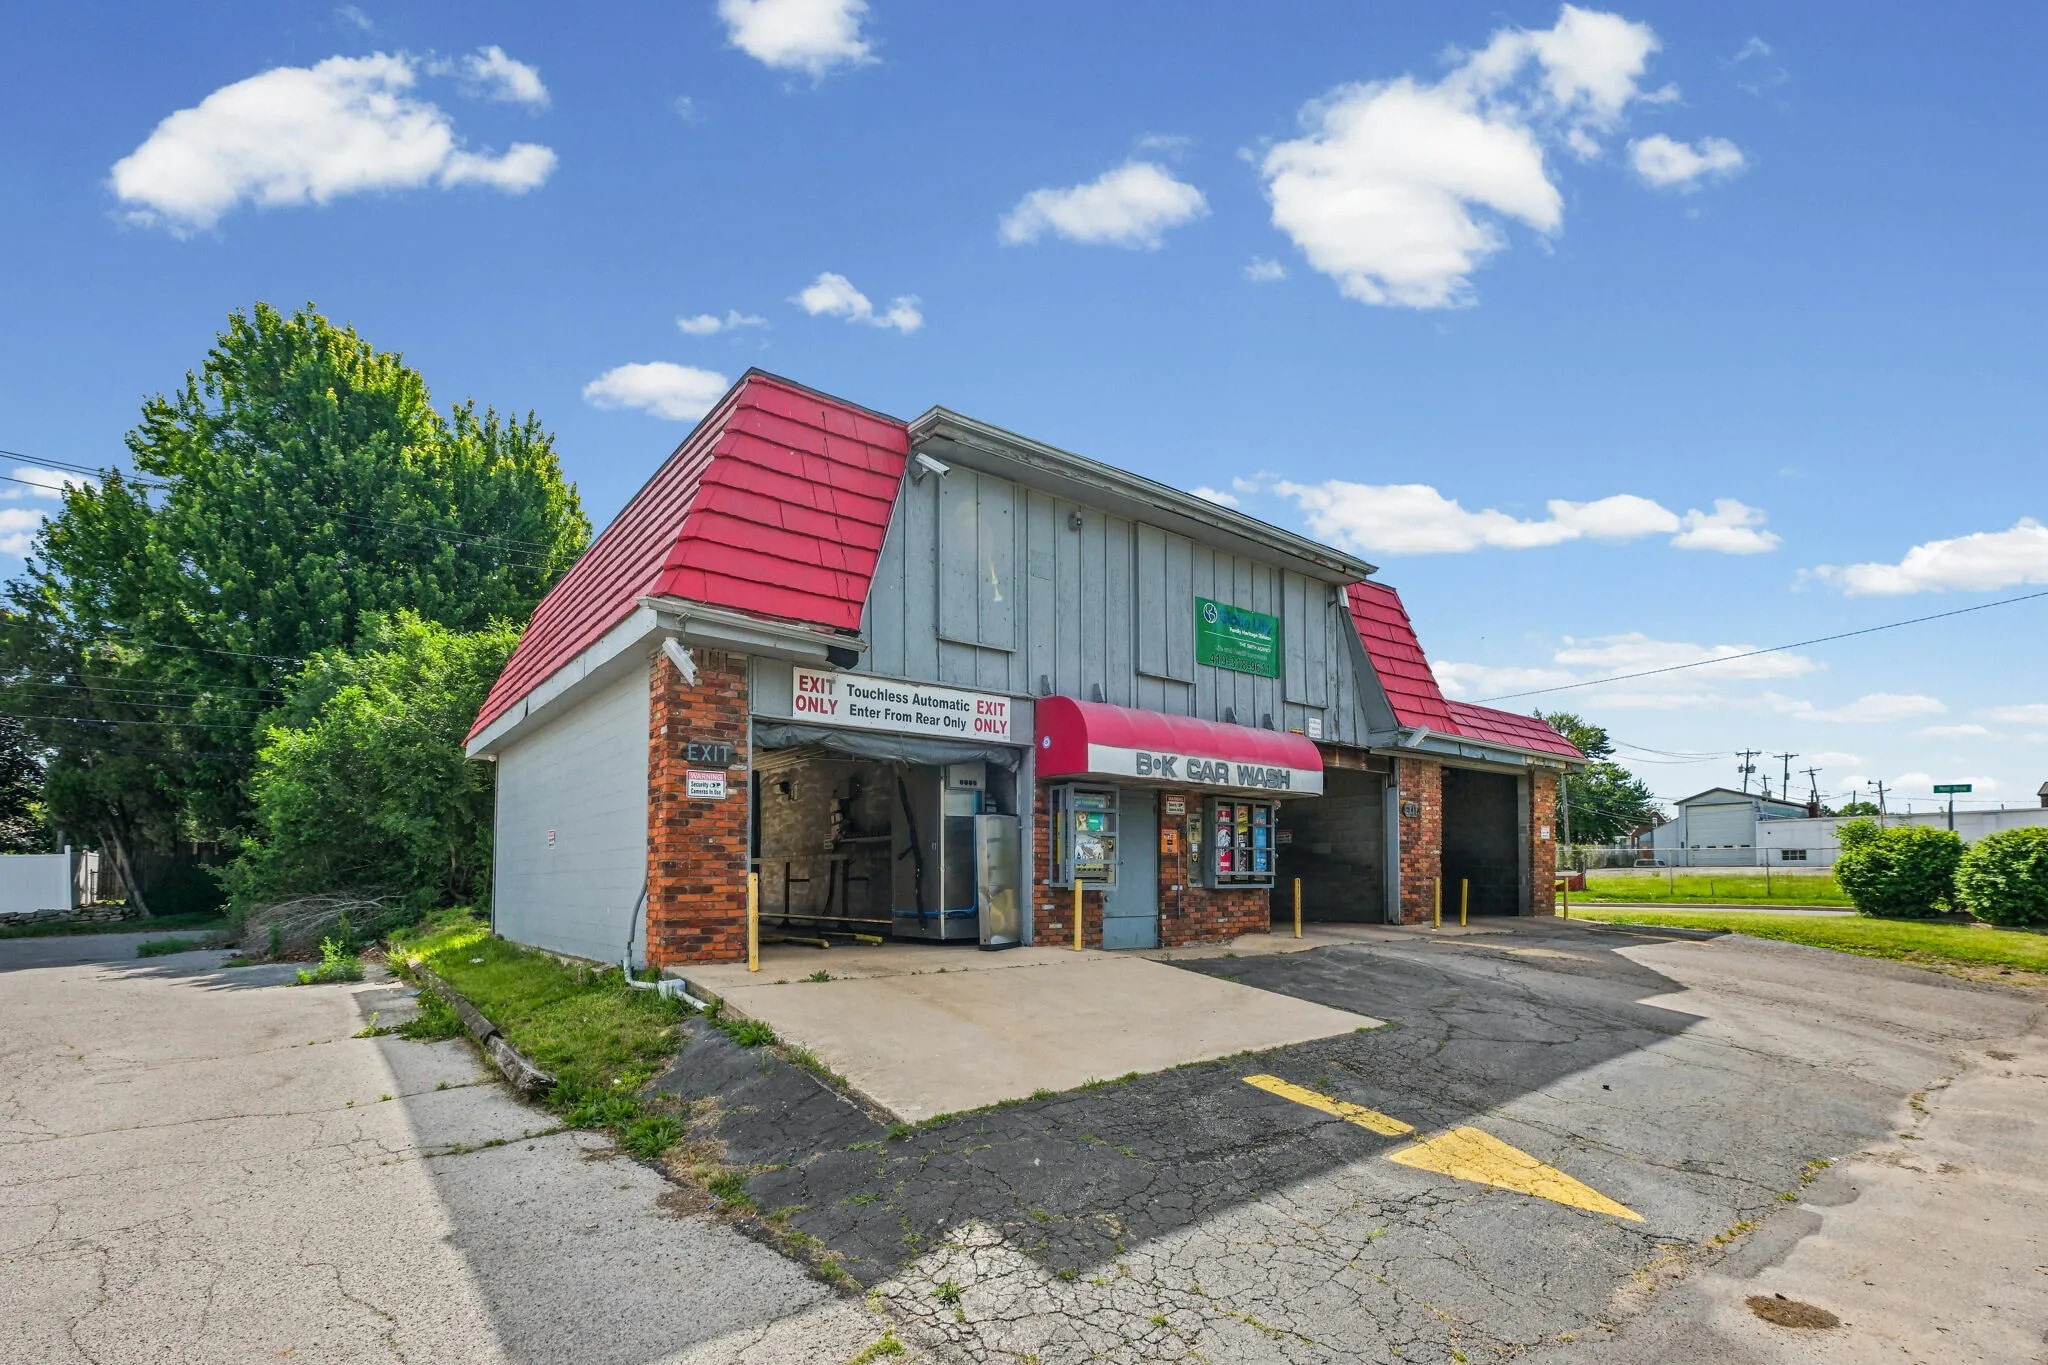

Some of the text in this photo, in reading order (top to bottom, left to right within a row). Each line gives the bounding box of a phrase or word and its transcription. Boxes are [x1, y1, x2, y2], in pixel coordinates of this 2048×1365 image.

[799, 675, 836, 695] EXIT
[795, 694, 839, 715] ONLY
[847, 683, 970, 712] Touchless Automatic
[850, 703, 967, 731] Enter From Rear Only
[976, 700, 1006, 716] EXIT
[974, 717, 1008, 734] ONLY
[687, 743, 731, 762] EXIT
[688, 771, 722, 781] WARNING
[1186, 758, 1230, 784] CAR
[1237, 765, 1290, 789] WASH
[690, 781, 709, 789] Security
